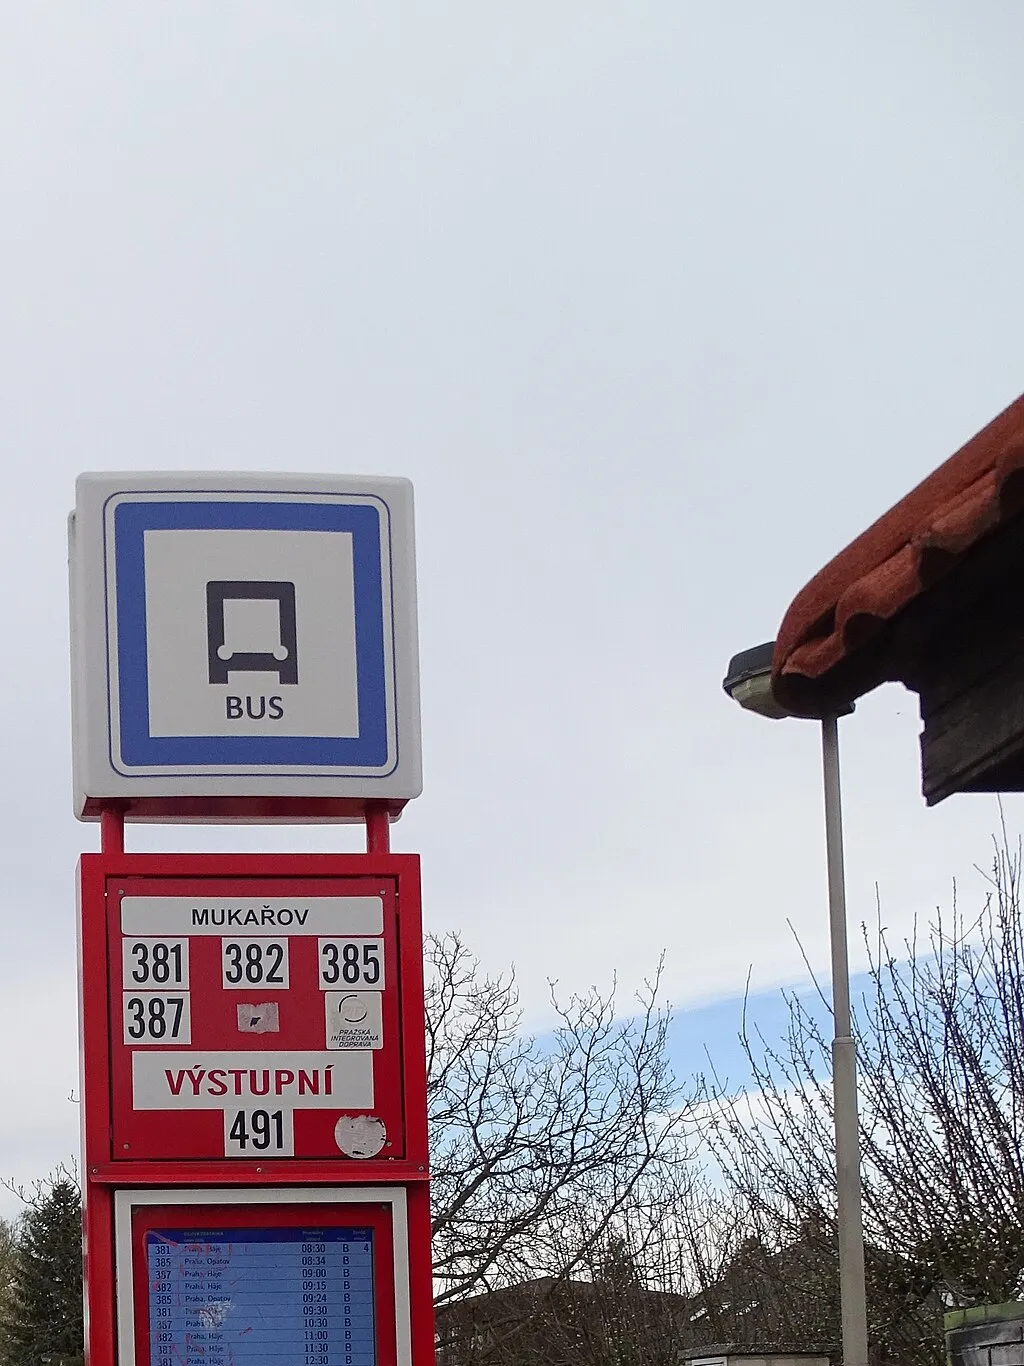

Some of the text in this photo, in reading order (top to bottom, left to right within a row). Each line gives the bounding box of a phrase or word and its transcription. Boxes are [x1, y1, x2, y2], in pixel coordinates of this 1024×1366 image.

[226, 696, 284, 720] BUS
[191, 905, 309, 926] MUKAŘOV
[131, 943, 183, 983] 381
[225, 944, 284, 983] 382
[322, 944, 379, 984] 385
[127, 998, 184, 1038] 387
[165, 1064, 335, 1096] VÝSTUPNÍ
[229, 1110, 284, 1150] 491
[156, 1245, 171, 1255] 381
[302, 1244, 325, 1253] 08:30
[343, 1244, 349, 1252] B
[364, 1244, 369, 1252] 4
[156, 1258, 171, 1268] 385
[302, 1257, 326, 1265] 08:34
[343, 1256, 350, 1265] B
[303, 1269, 326, 1277] 09:00
[344, 1269, 350, 1277] B
[303, 1281, 326, 1290] 09:15
[344, 1281, 350, 1289] B
[156, 1296, 172, 1305] 385
[303, 1294, 327, 1302] 09:24
[344, 1293, 350, 1302] B
[156, 1308, 172, 1317] 381
[303, 1306, 327, 1315] 09:30
[344, 1306, 350, 1314] B
[304, 1319, 327, 1327] 10:30
[345, 1318, 351, 1327] B
[304, 1331, 328, 1340] 11:00
[345, 1331, 351, 1339] B
[305, 1343, 328, 1352] 11:30
[345, 1343, 352, 1352] B
[305, 1356, 328, 1364] 12:30
[346, 1356, 352, 1364] B
